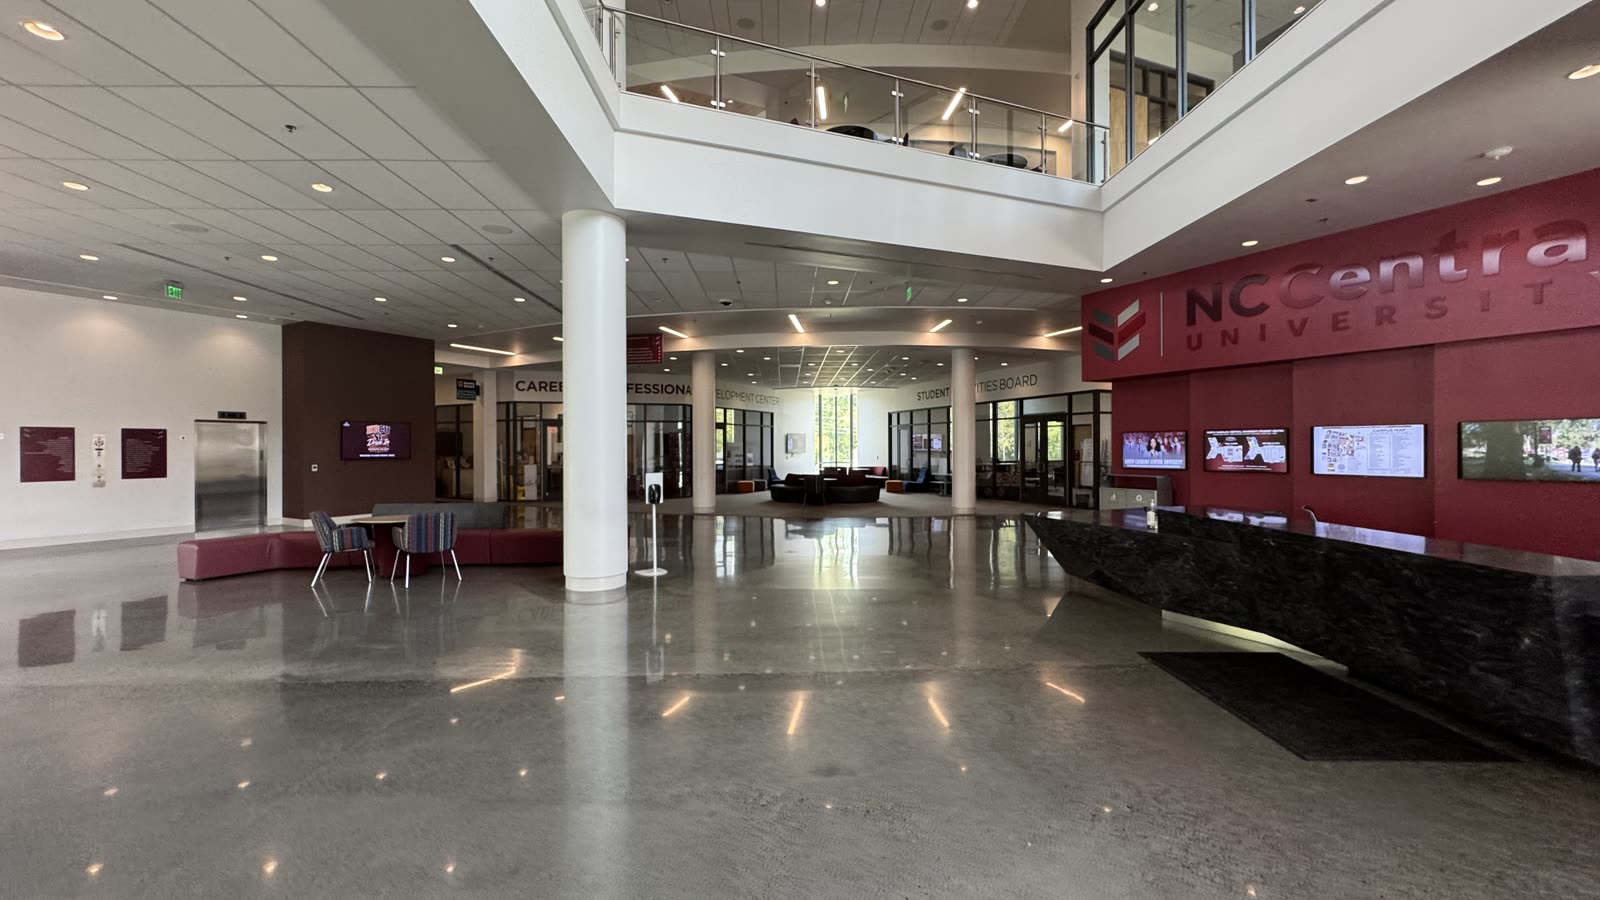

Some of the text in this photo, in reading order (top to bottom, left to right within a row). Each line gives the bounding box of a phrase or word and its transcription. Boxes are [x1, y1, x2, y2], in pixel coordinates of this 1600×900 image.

[1186, 270, 1600, 351] UNIVERSIT
[627, 383, 692, 395] FESSIONA
[716, 389, 754, 402] ELOPMENT
[917, 387, 950, 401] STUDENT
[1000, 374, 1038, 390] BOARD
